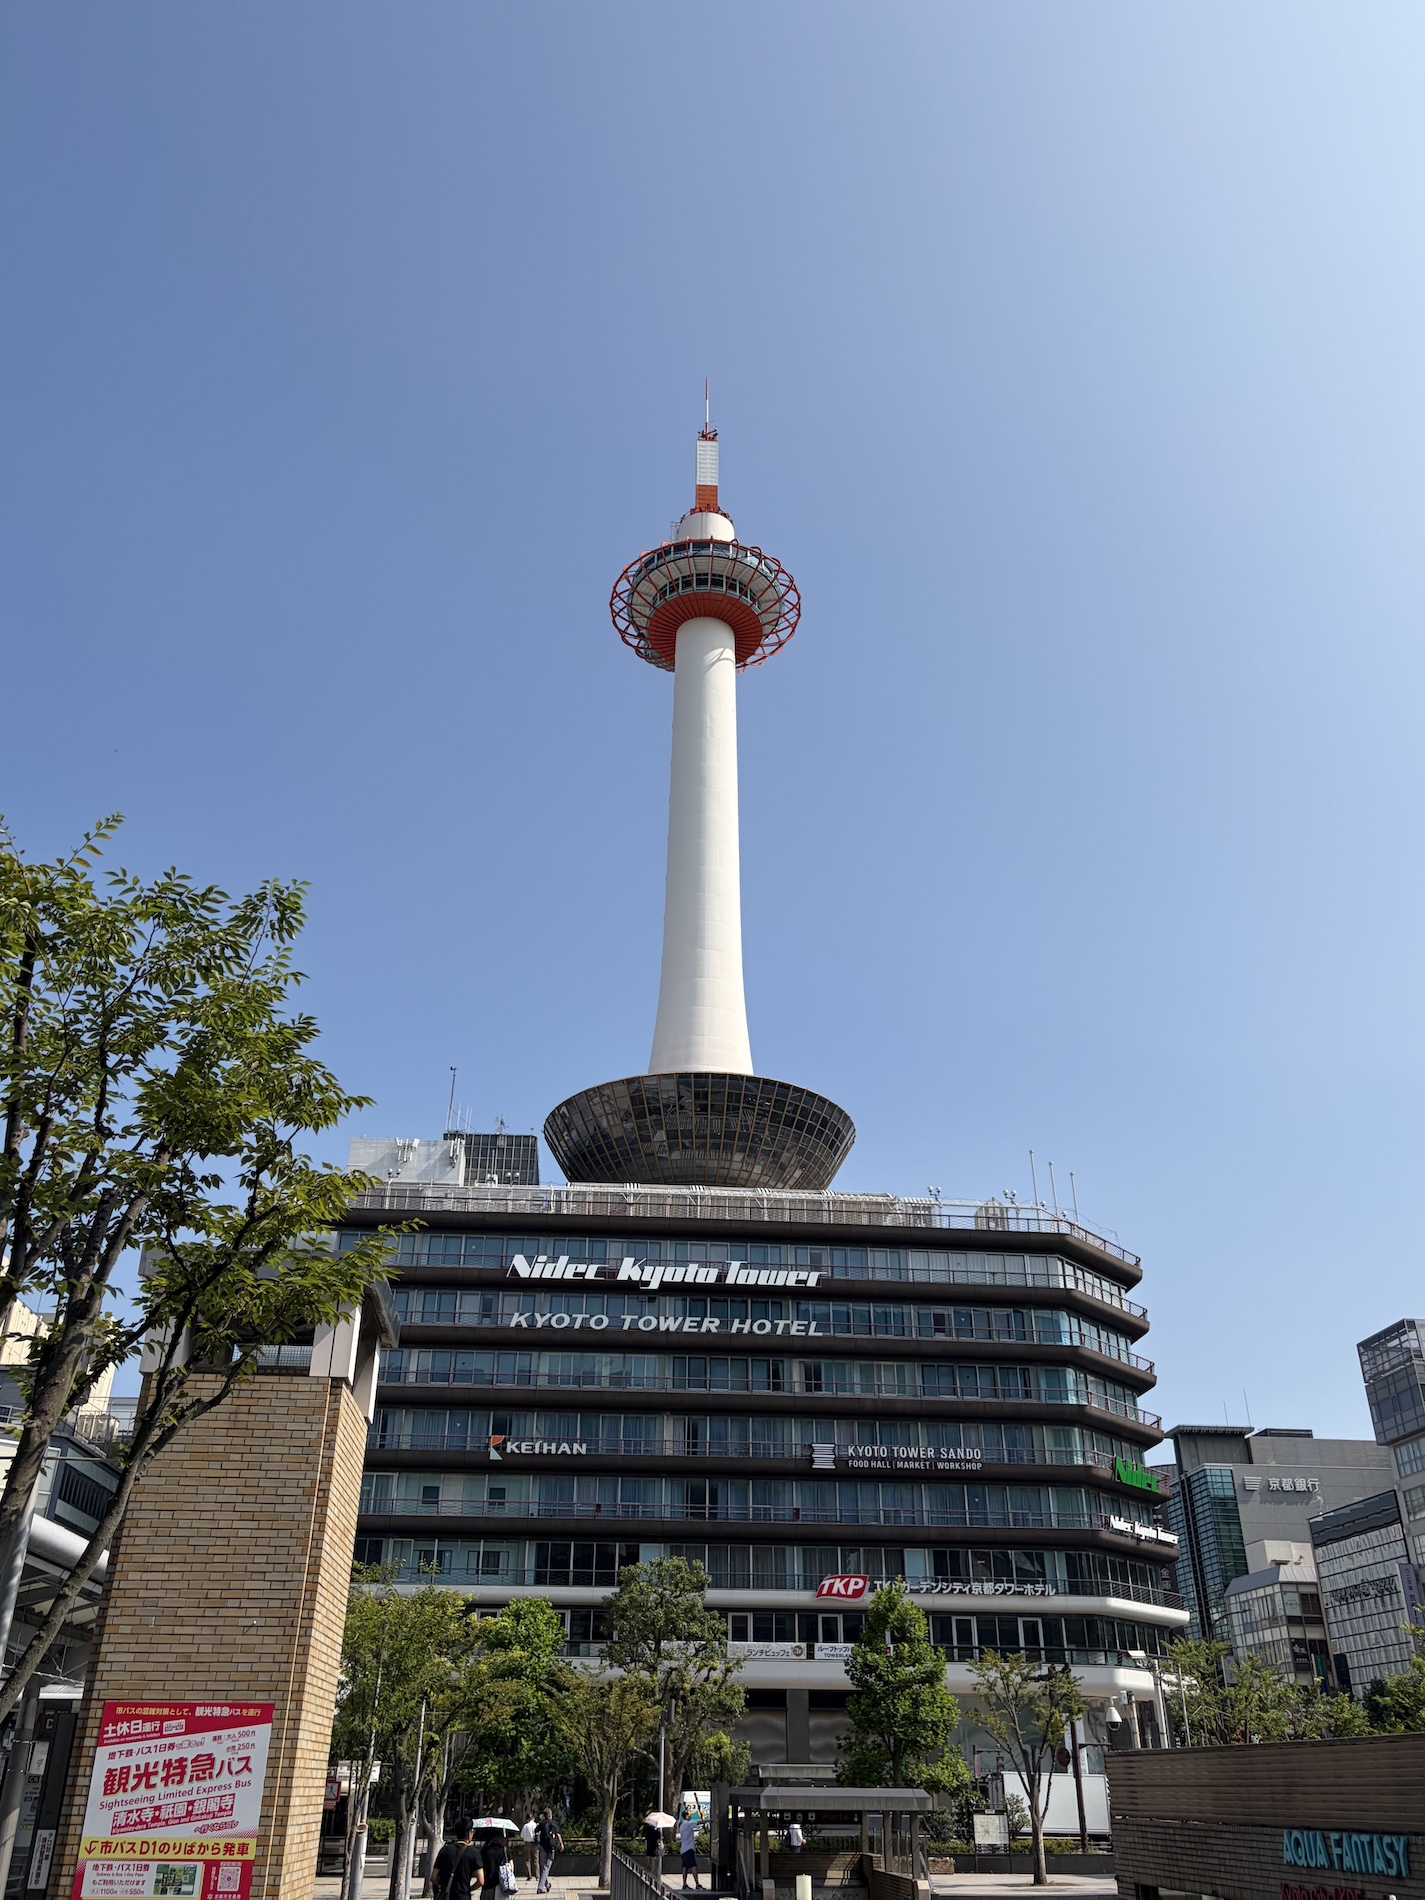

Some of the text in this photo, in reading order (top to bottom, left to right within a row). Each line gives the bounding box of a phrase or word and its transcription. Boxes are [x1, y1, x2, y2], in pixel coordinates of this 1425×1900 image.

[506, 1254, 828, 1290] Nidec Kyoto Tower
[509, 1312, 825, 1337] KYOTO TOWER HOTEL
[506, 1441, 587, 1455] KEIHAN
[848, 1446, 981, 1460] KYOTO TOWER SANDO
[849, 1460, 982, 1470] FOOD HALL MARKET WORKSHOP
[1115, 1456, 1161, 1494] Nidec
[1267, 1477, 1320, 1493] 京都銀行
[820, 1577, 865, 1596] TKP
[874, 1580, 1056, 1596] TKガーデンシティ京都タワーホテル
[103, 1720, 160, 1739] 土休日運行
[102, 1752, 252, 1797] 観光特急バス
[99, 1779, 252, 1810] Sightseeing Limited Express Bus
[1283, 1829, 1409, 1878] AQUA FANTASY
